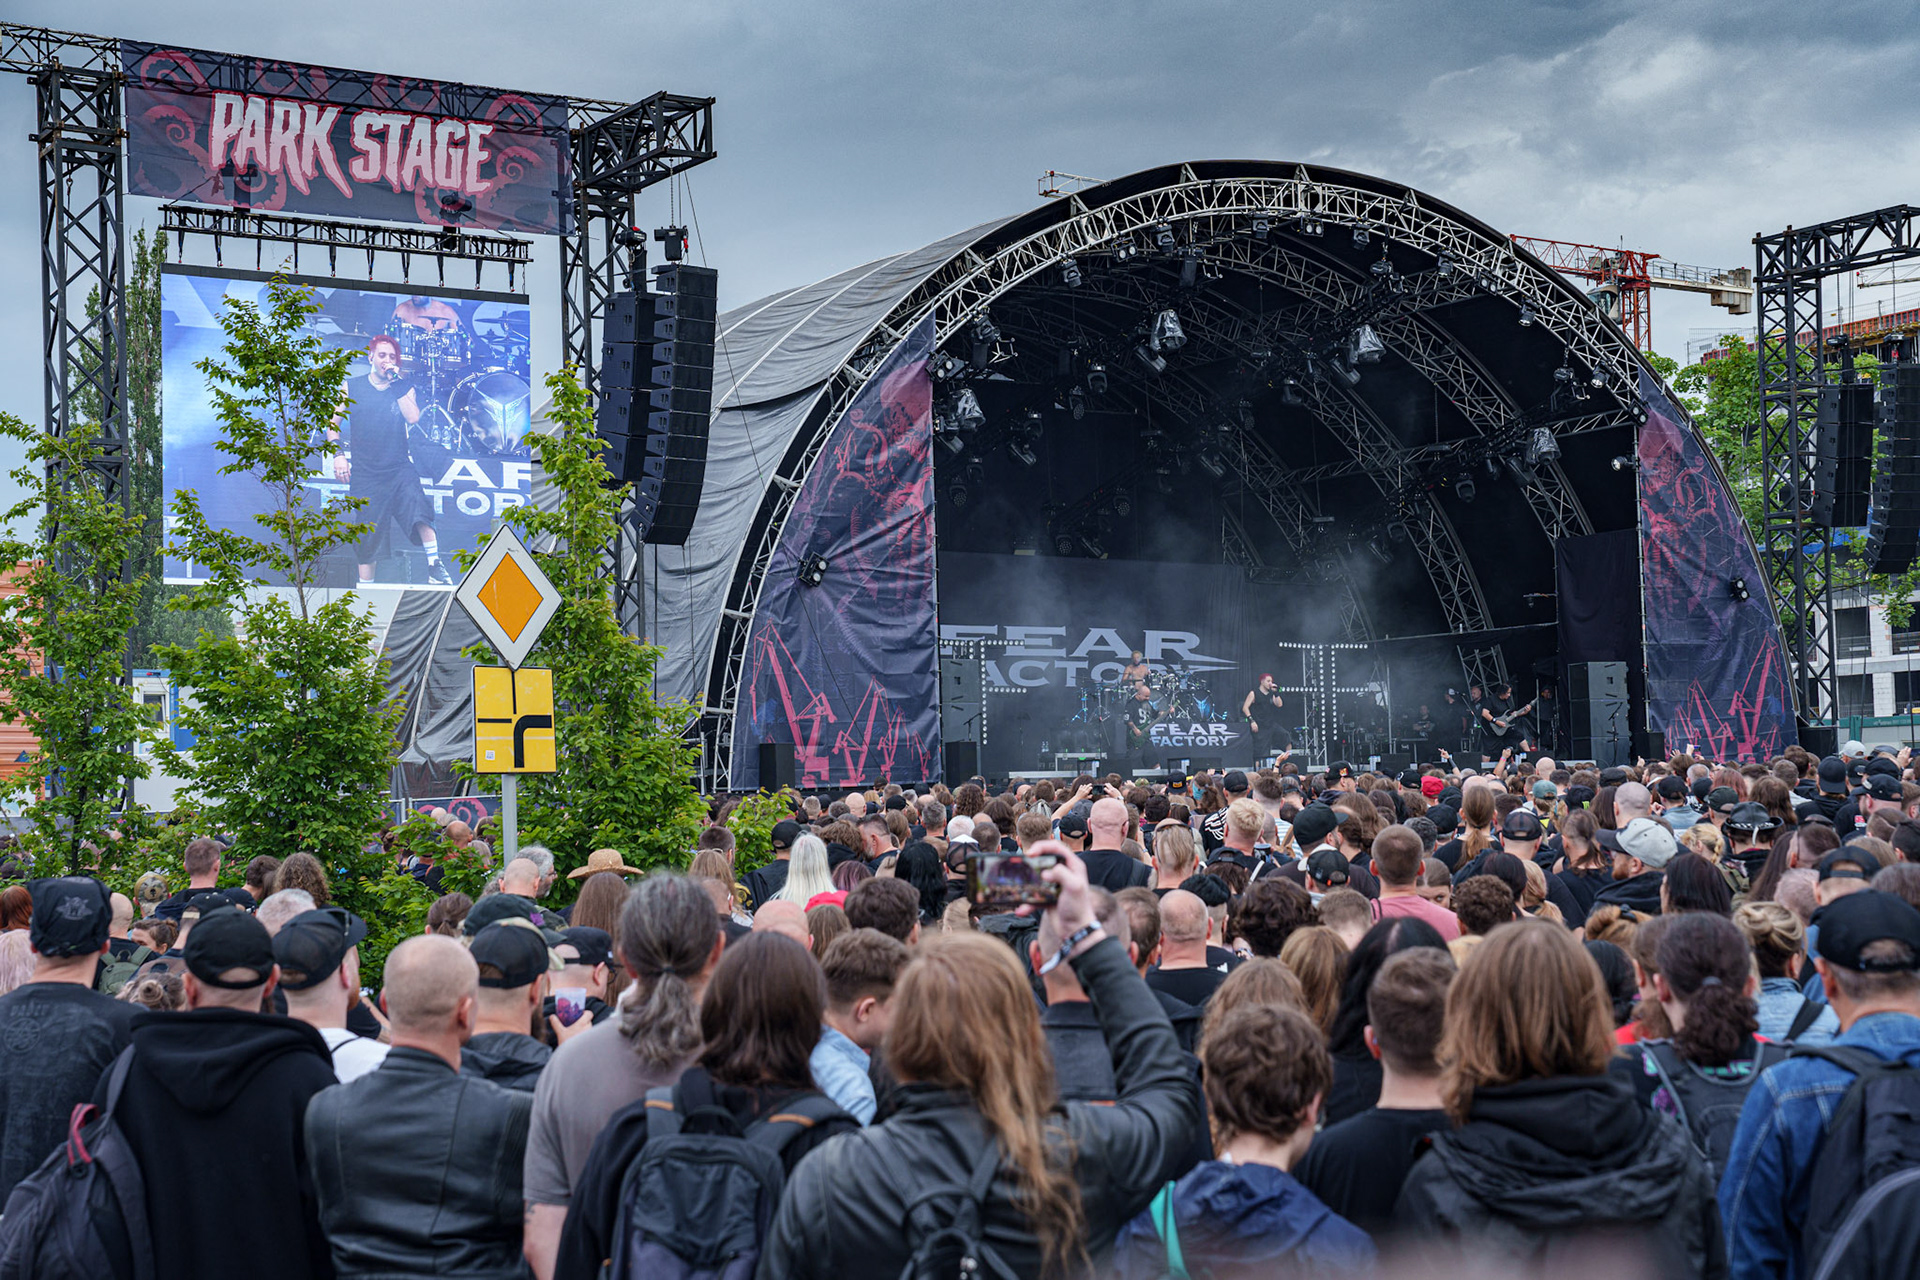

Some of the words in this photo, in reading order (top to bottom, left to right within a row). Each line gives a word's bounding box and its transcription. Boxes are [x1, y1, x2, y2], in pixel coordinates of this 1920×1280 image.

[210, 90, 353, 198] PARK
[349, 109, 496, 194] STAGE
[1150, 723, 1240, 736] FEAR
[1150, 735, 1240, 747] FACTORY
